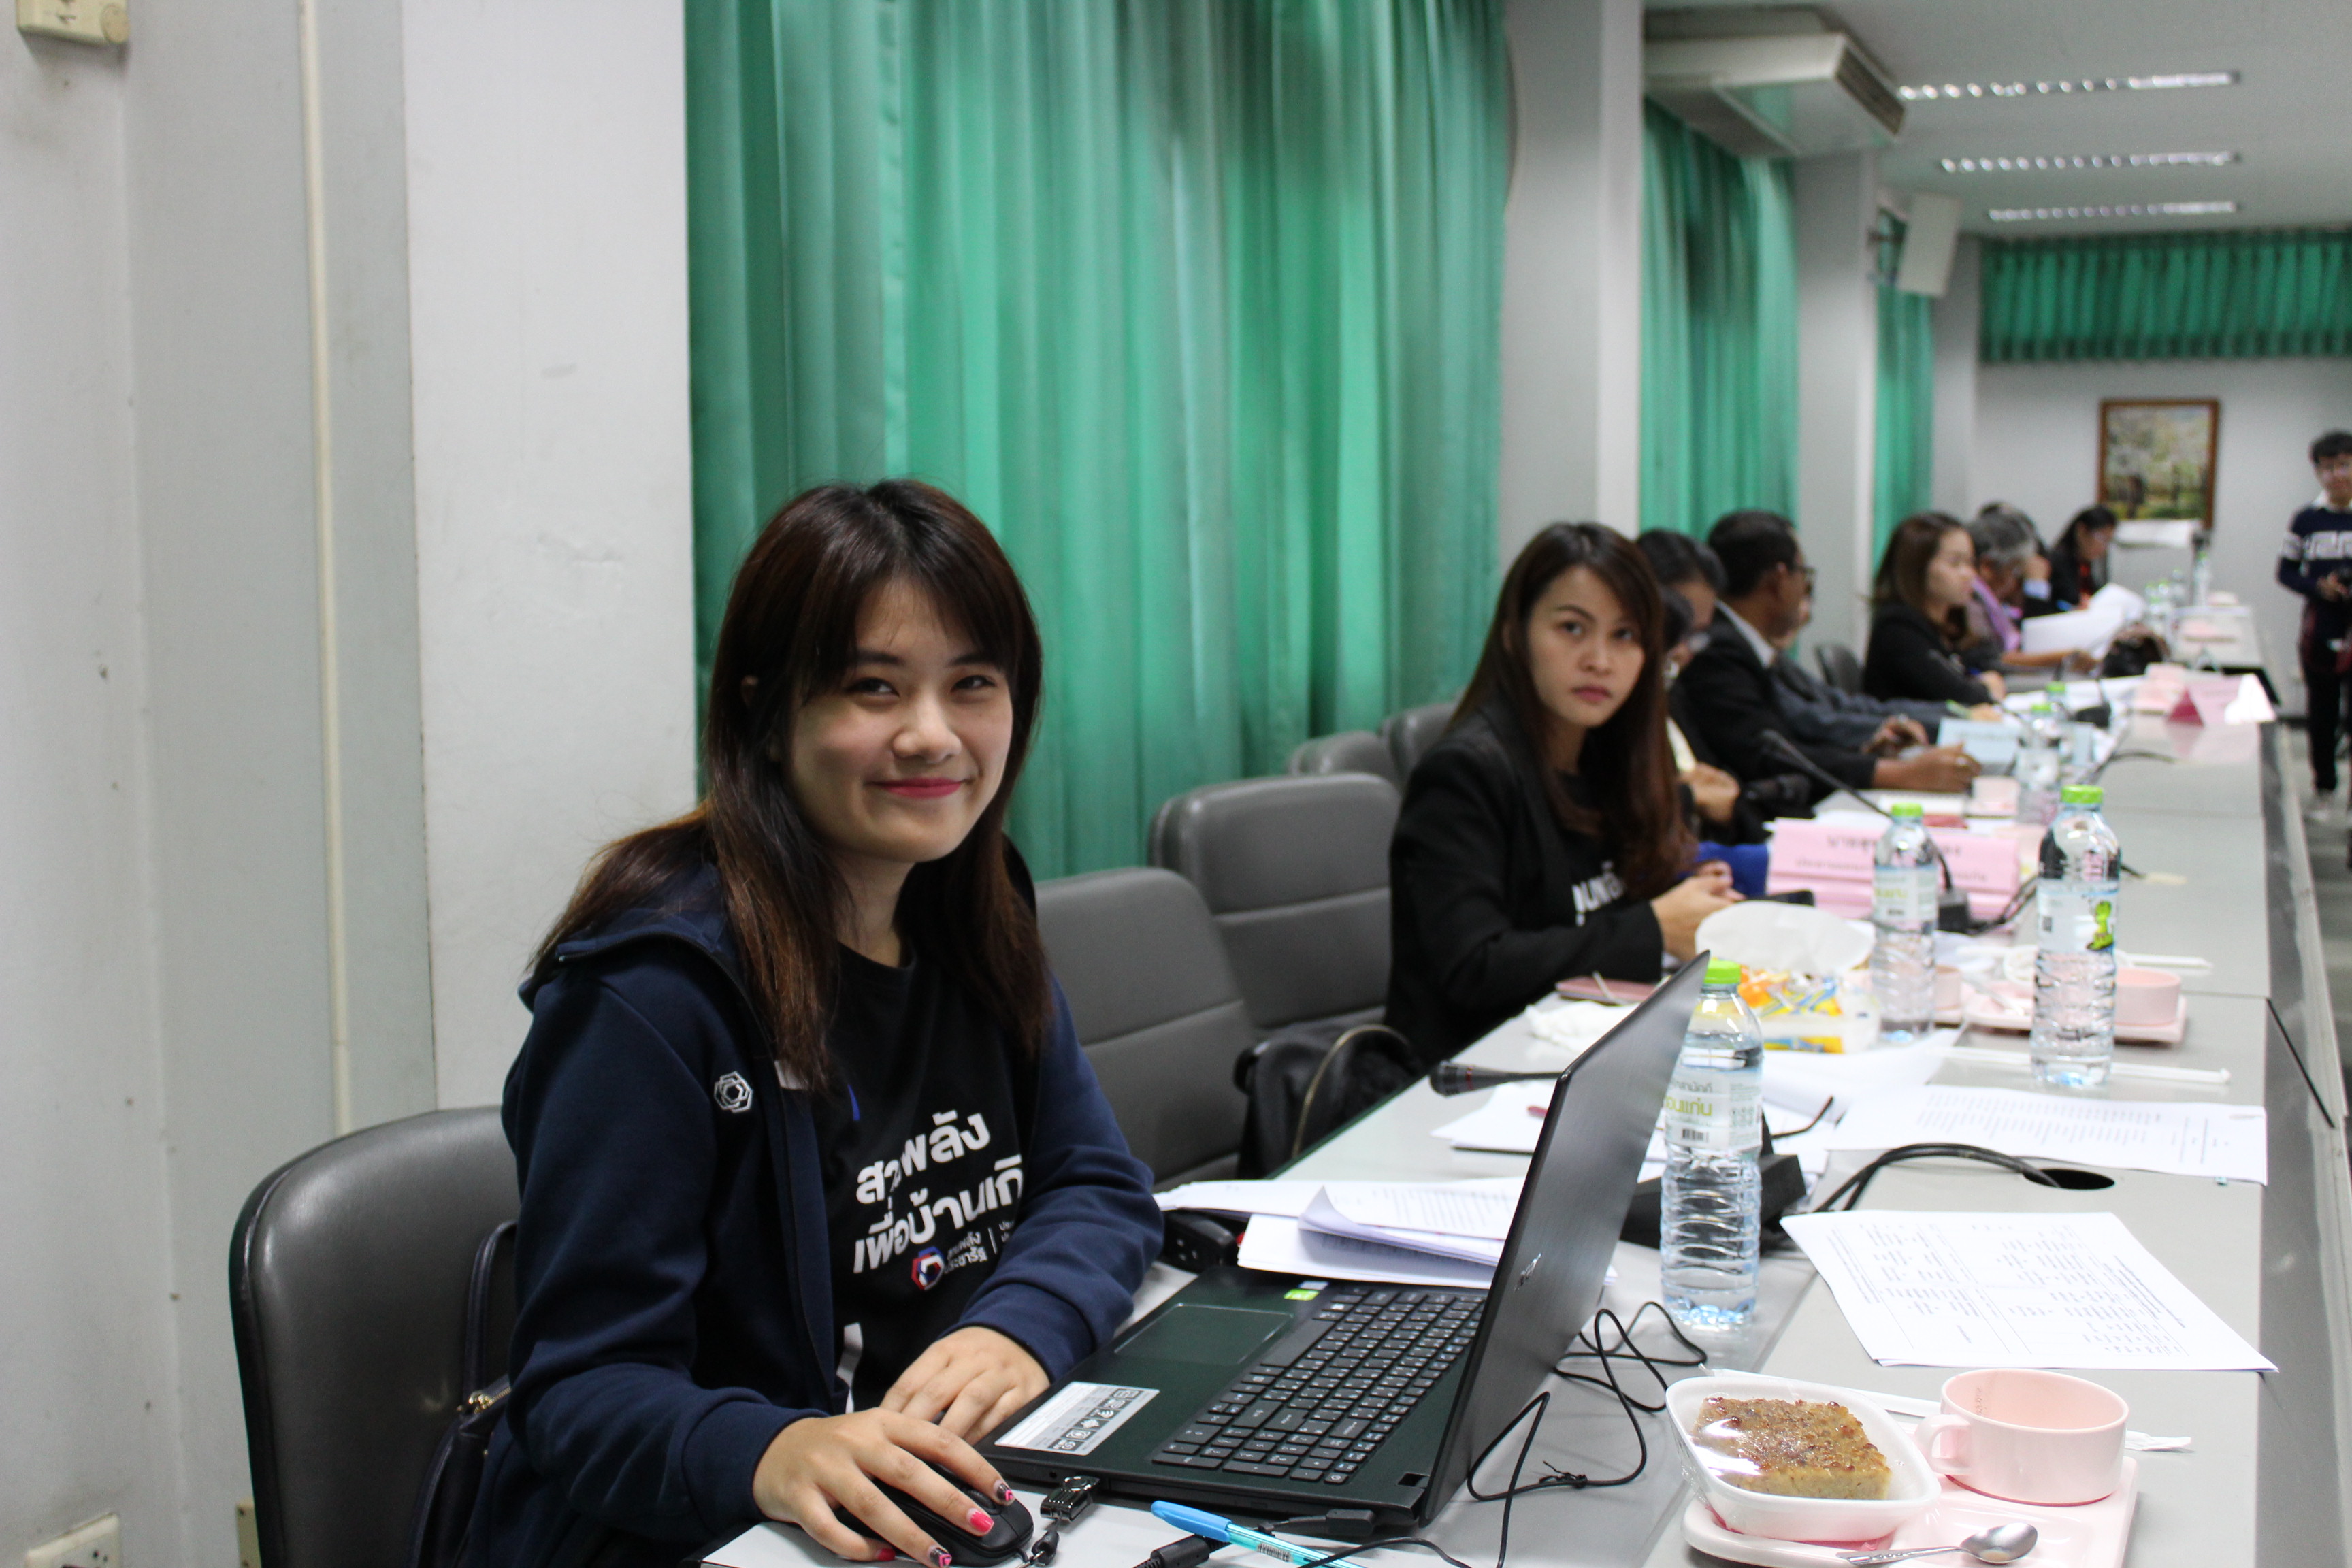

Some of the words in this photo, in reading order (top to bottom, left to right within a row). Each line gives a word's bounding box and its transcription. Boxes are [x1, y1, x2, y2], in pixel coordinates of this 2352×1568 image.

[1665, 1096, 1713, 1117] อนแก่น
[853, 1154, 1024, 1274] เพื่อบ้านเกิ
